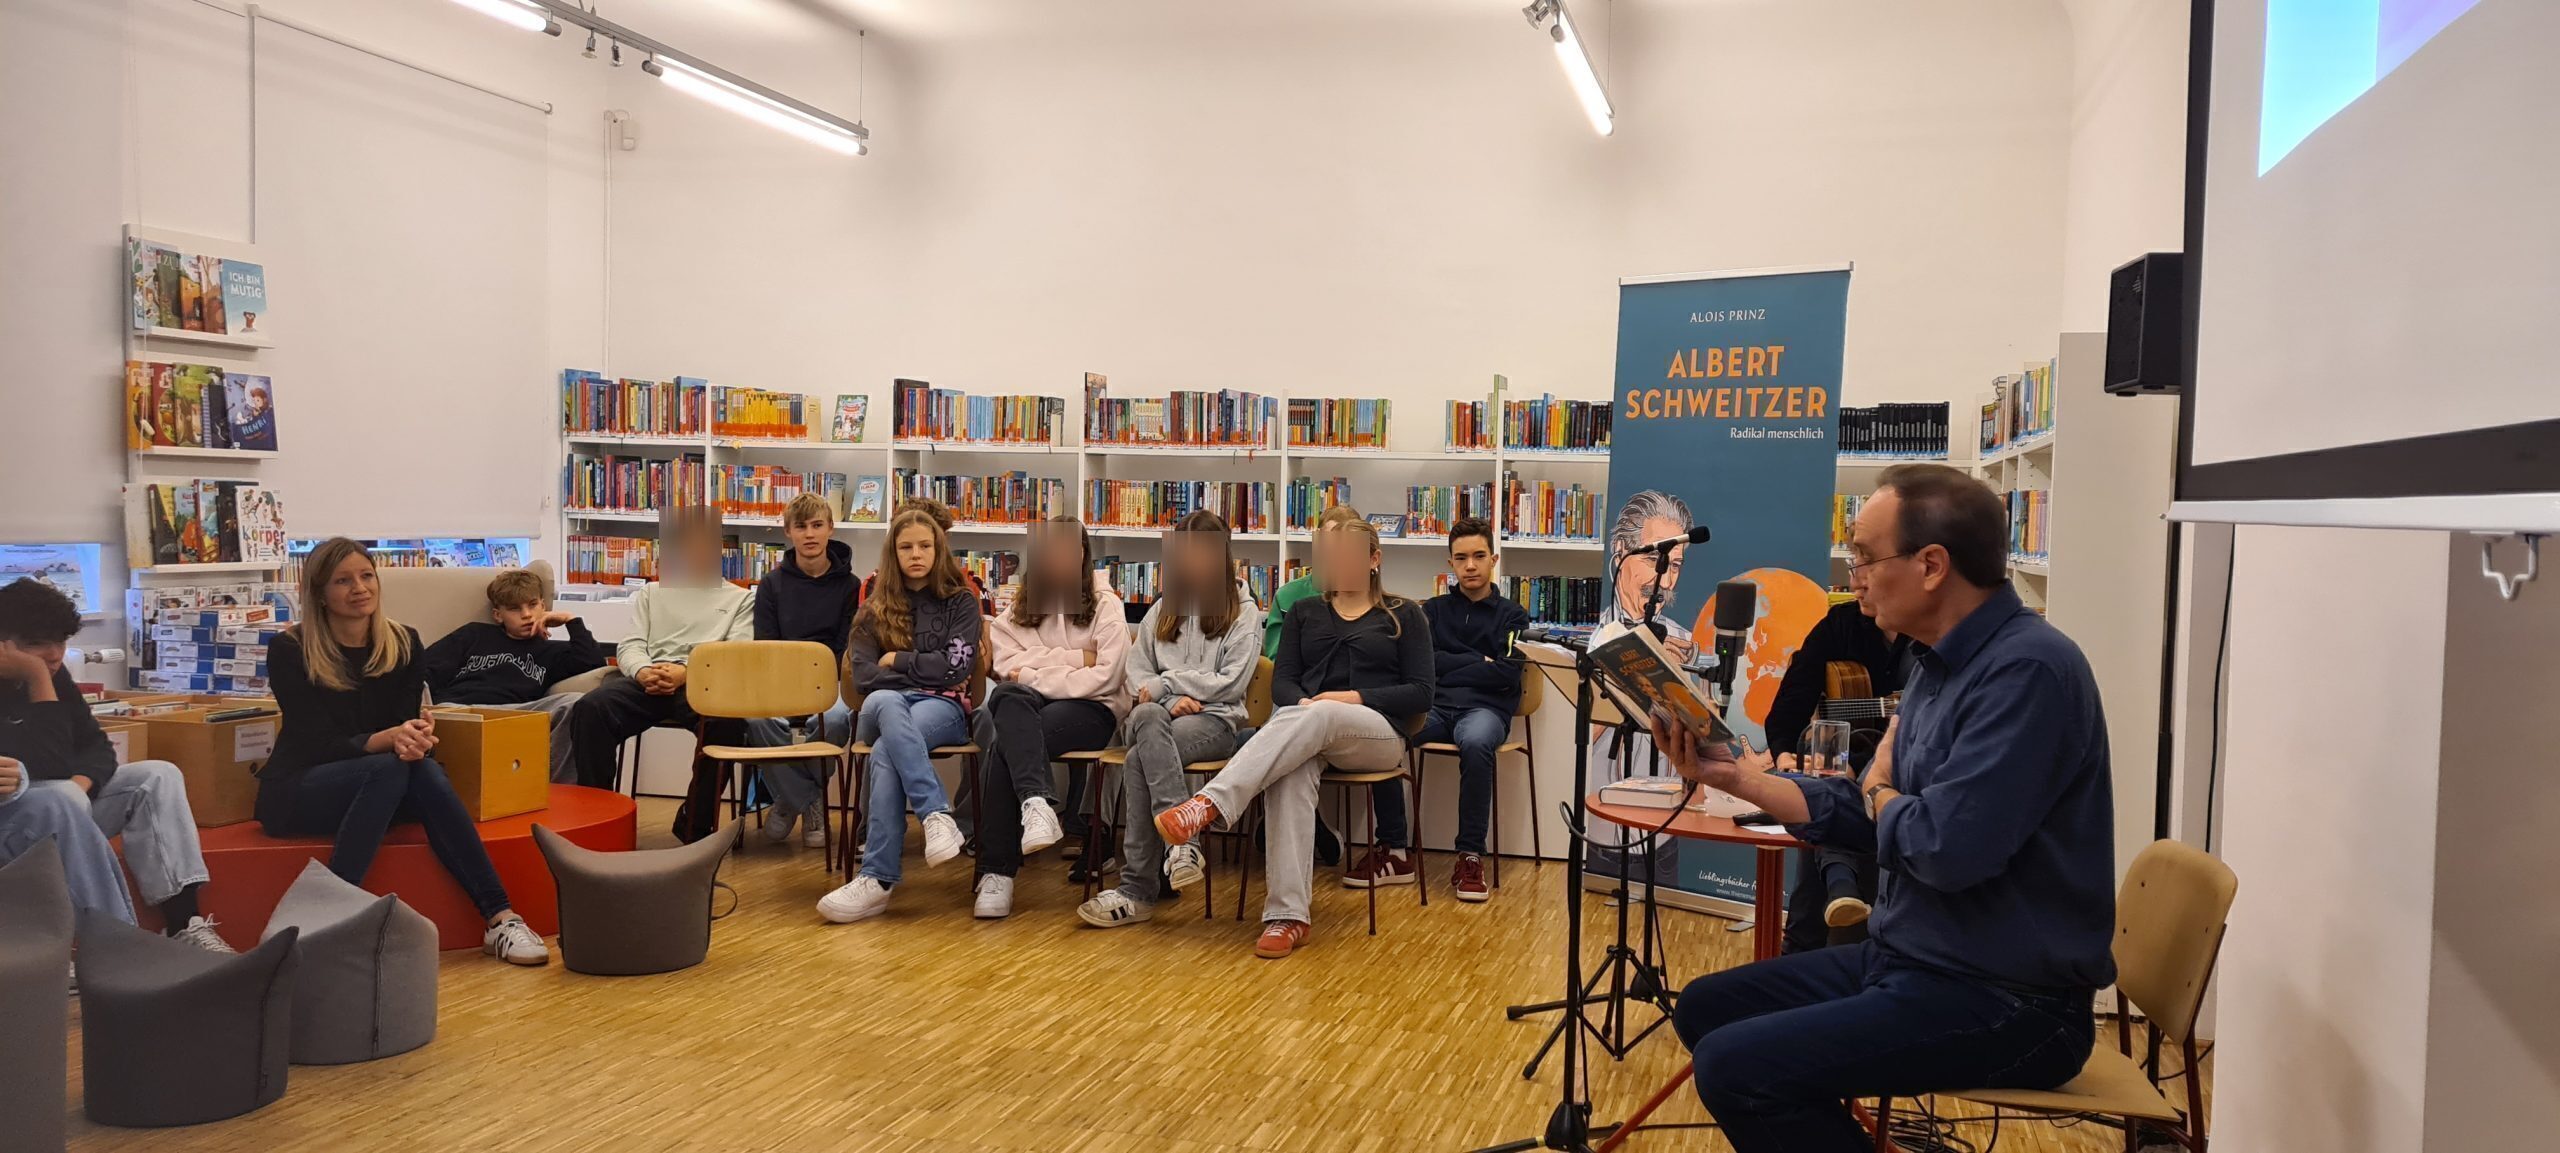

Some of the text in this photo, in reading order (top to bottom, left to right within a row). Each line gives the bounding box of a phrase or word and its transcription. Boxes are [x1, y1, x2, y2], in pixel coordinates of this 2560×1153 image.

[229, 271, 260, 285] ICH BIN
[230, 284, 262, 298] MUTIG
[1690, 309, 1766, 323] ALOIS PRINZ
[1667, 346, 1785, 379] ALBERT
[1625, 387, 1827, 419] SCHWEITZER
[241, 420, 267, 435] HENRI
[1730, 427, 1824, 439] Radikal menschlich
[1699, 870, 1750, 888] Lieblingsbücher
